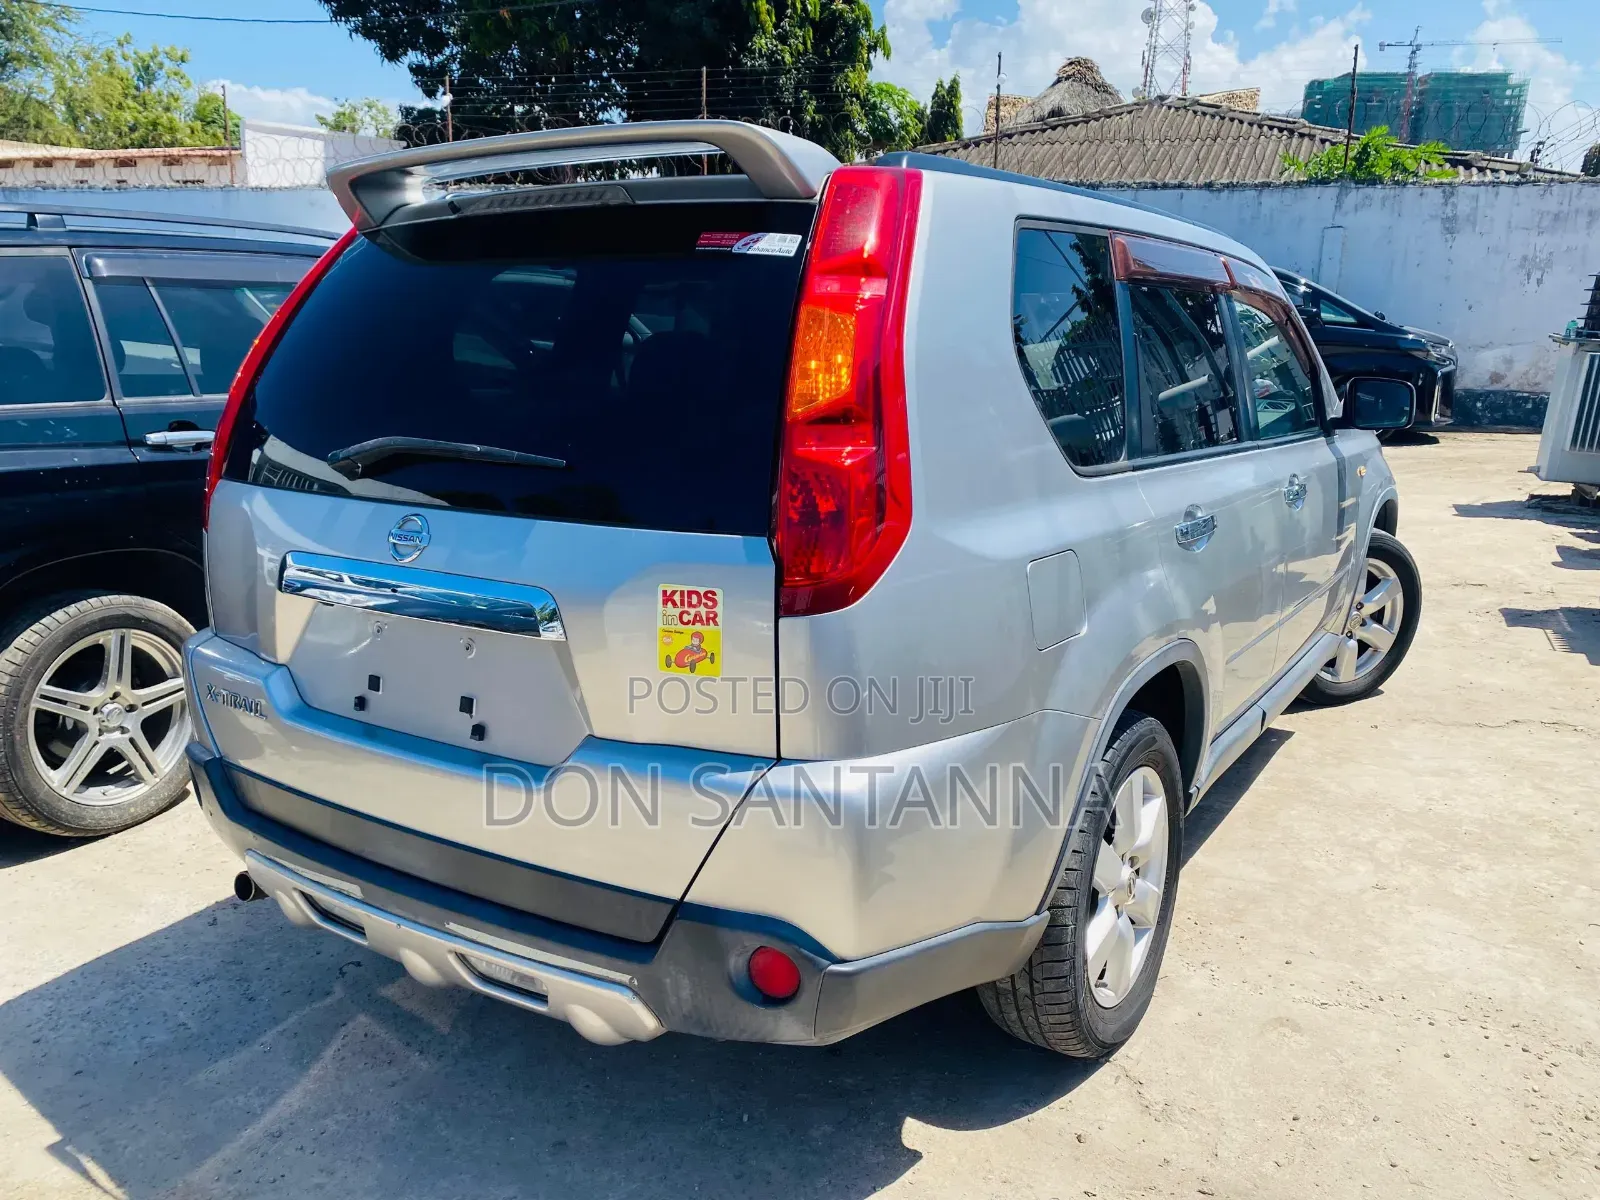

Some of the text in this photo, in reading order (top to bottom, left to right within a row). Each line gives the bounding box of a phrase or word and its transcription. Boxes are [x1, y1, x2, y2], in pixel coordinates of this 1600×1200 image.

[775, 247, 793, 255] Auto
[390, 532, 424, 544] NISSAN
[662, 590, 718, 609] KIDS
[678, 609, 719, 627] CAR
[206, 682, 268, 721] X-TRAIL
